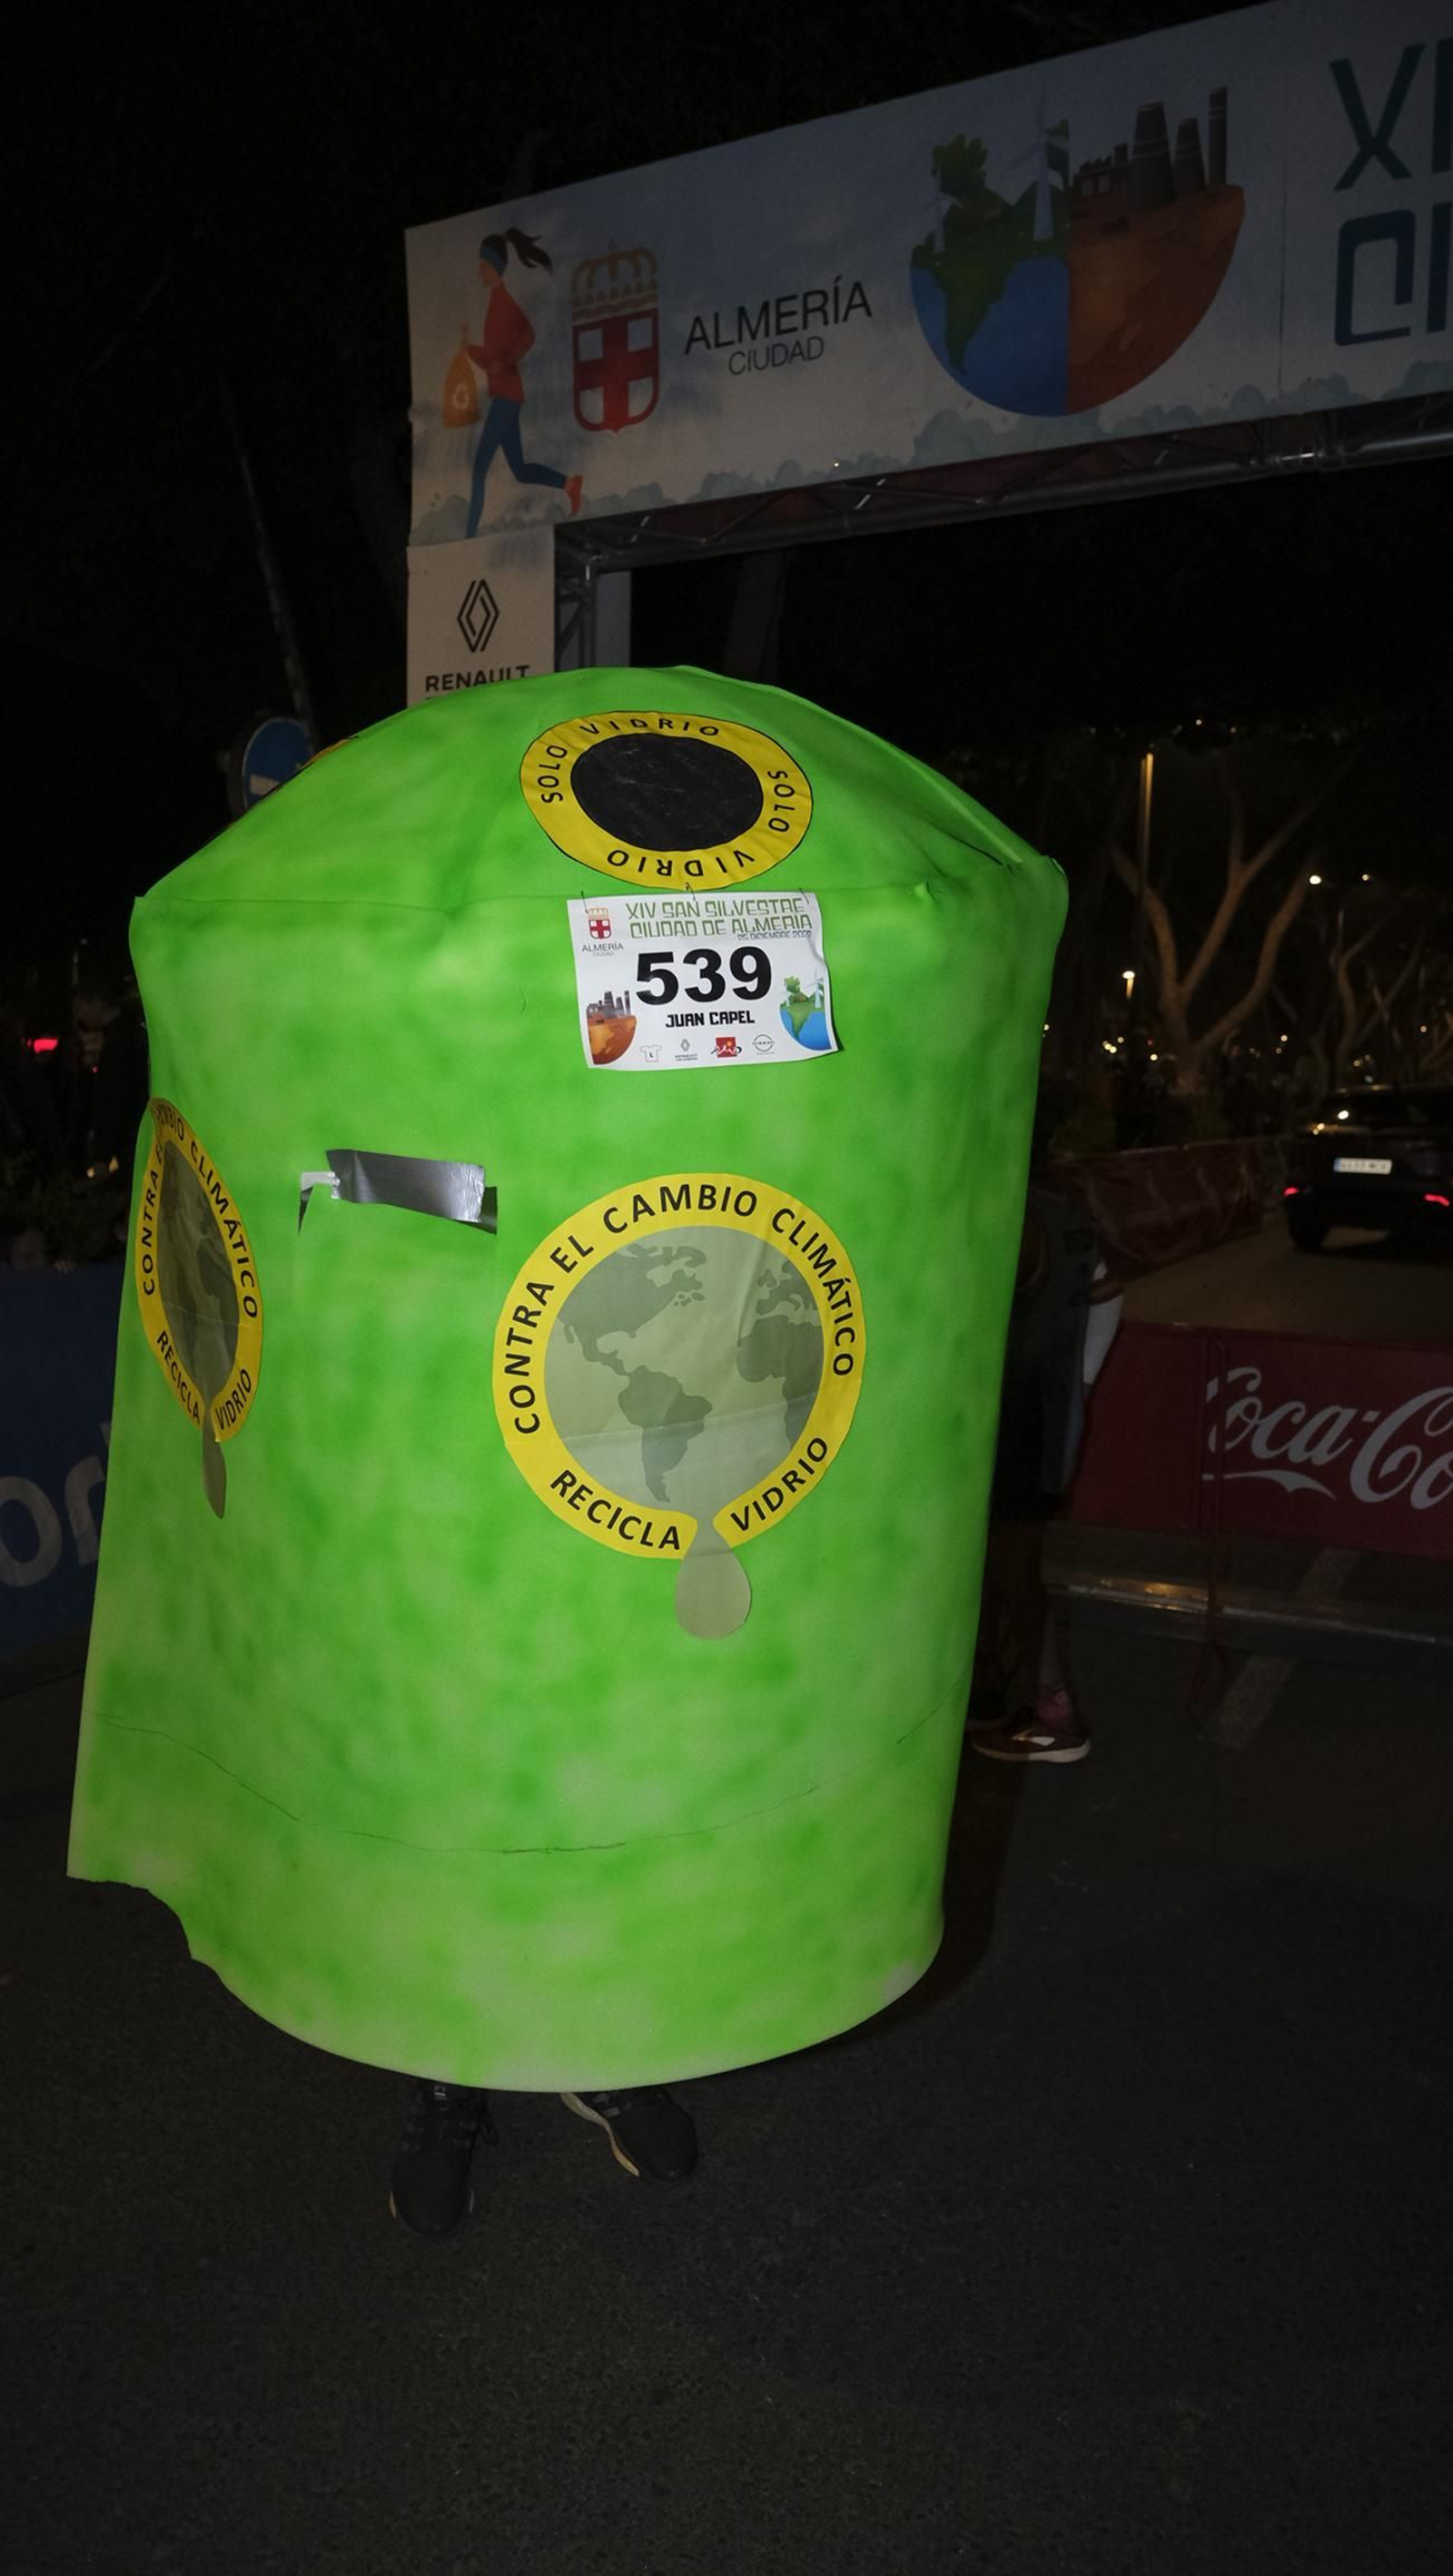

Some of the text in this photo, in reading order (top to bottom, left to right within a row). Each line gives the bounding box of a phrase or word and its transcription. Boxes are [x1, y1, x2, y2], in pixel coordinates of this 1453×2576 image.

[685, 275, 872, 355] ALMERÍA
[728, 336, 824, 376] CIUDAD
[537, 718, 719, 804] SOLO VIDRIO
[607, 770, 796, 876] SOLO VIDRIO
[581, 942, 624, 952] ALMERÍA
[626, 898, 805, 919] XIV SAN SILVESTRE
[630, 921, 697, 939] CIUDAD
[702, 920, 727, 936] DE
[636, 946, 772, 1005] 539
[666, 1011, 755, 1028] JUAN CAPEL
[143, 1170, 158, 1296] CONTRA
[190, 1140, 258, 1318] CLIMÁTICO
[505, 1184, 855, 1435] CONTRA EL CAMBIO CLIMÁTICO
[156, 1330, 252, 1430] RECICLA VIDRIO
[550, 1437, 827, 1551] RECICLA VIDRIO
